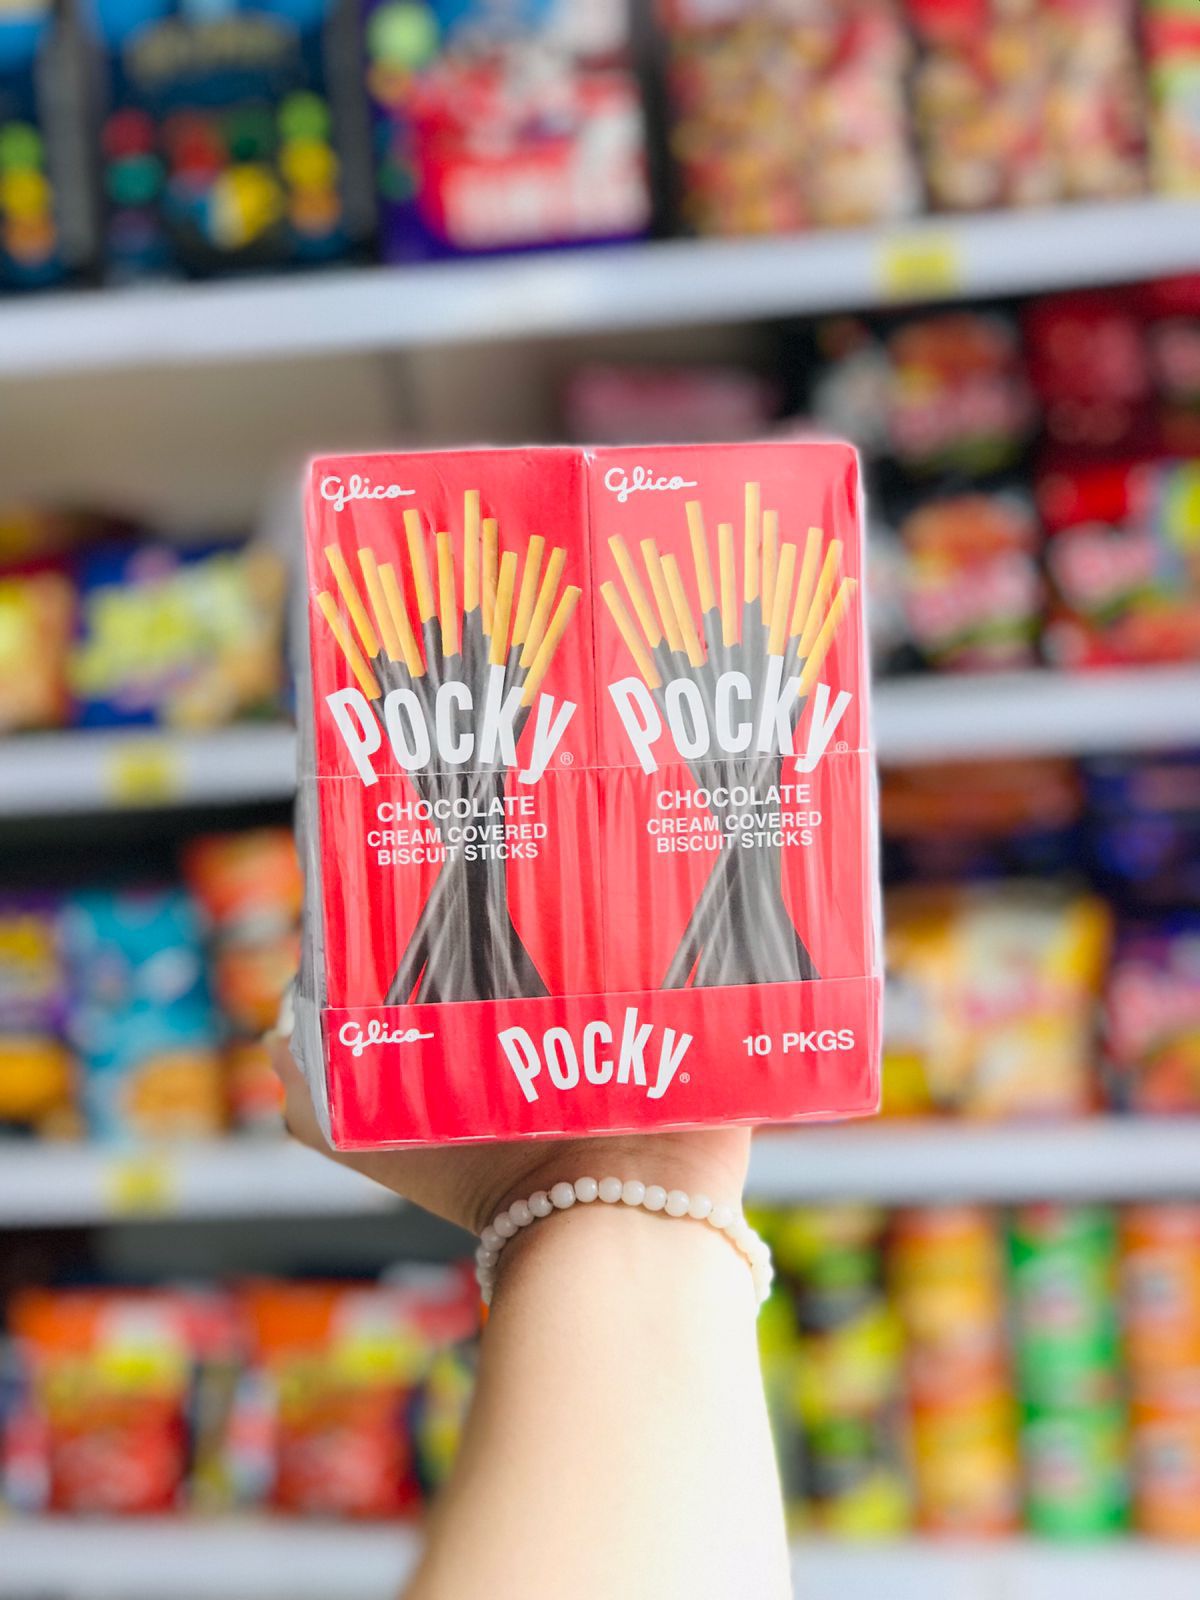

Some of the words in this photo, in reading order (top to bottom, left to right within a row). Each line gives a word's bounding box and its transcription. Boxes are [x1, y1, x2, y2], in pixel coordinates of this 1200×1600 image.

[320, 475, 415, 511] Glico
[604, 466, 697, 502] Glico
[377, 795, 535, 823] CHOCOLATE
[656, 784, 810, 811] CHOCOLATE
[367, 826, 442, 847] CREAM
[446, 822, 547, 844] COVERED
[646, 815, 720, 835] CREAM
[724, 810, 822, 832] COVERED
[377, 844, 459, 865] BISCUIT
[463, 842, 538, 862] STICKS
[656, 831, 737, 853] BISCUIT
[741, 829, 813, 849] STICKS
[338, 1021, 434, 1057] Glico
[743, 1034, 772, 1057] 10
[782, 1029, 855, 1054] PKGS
